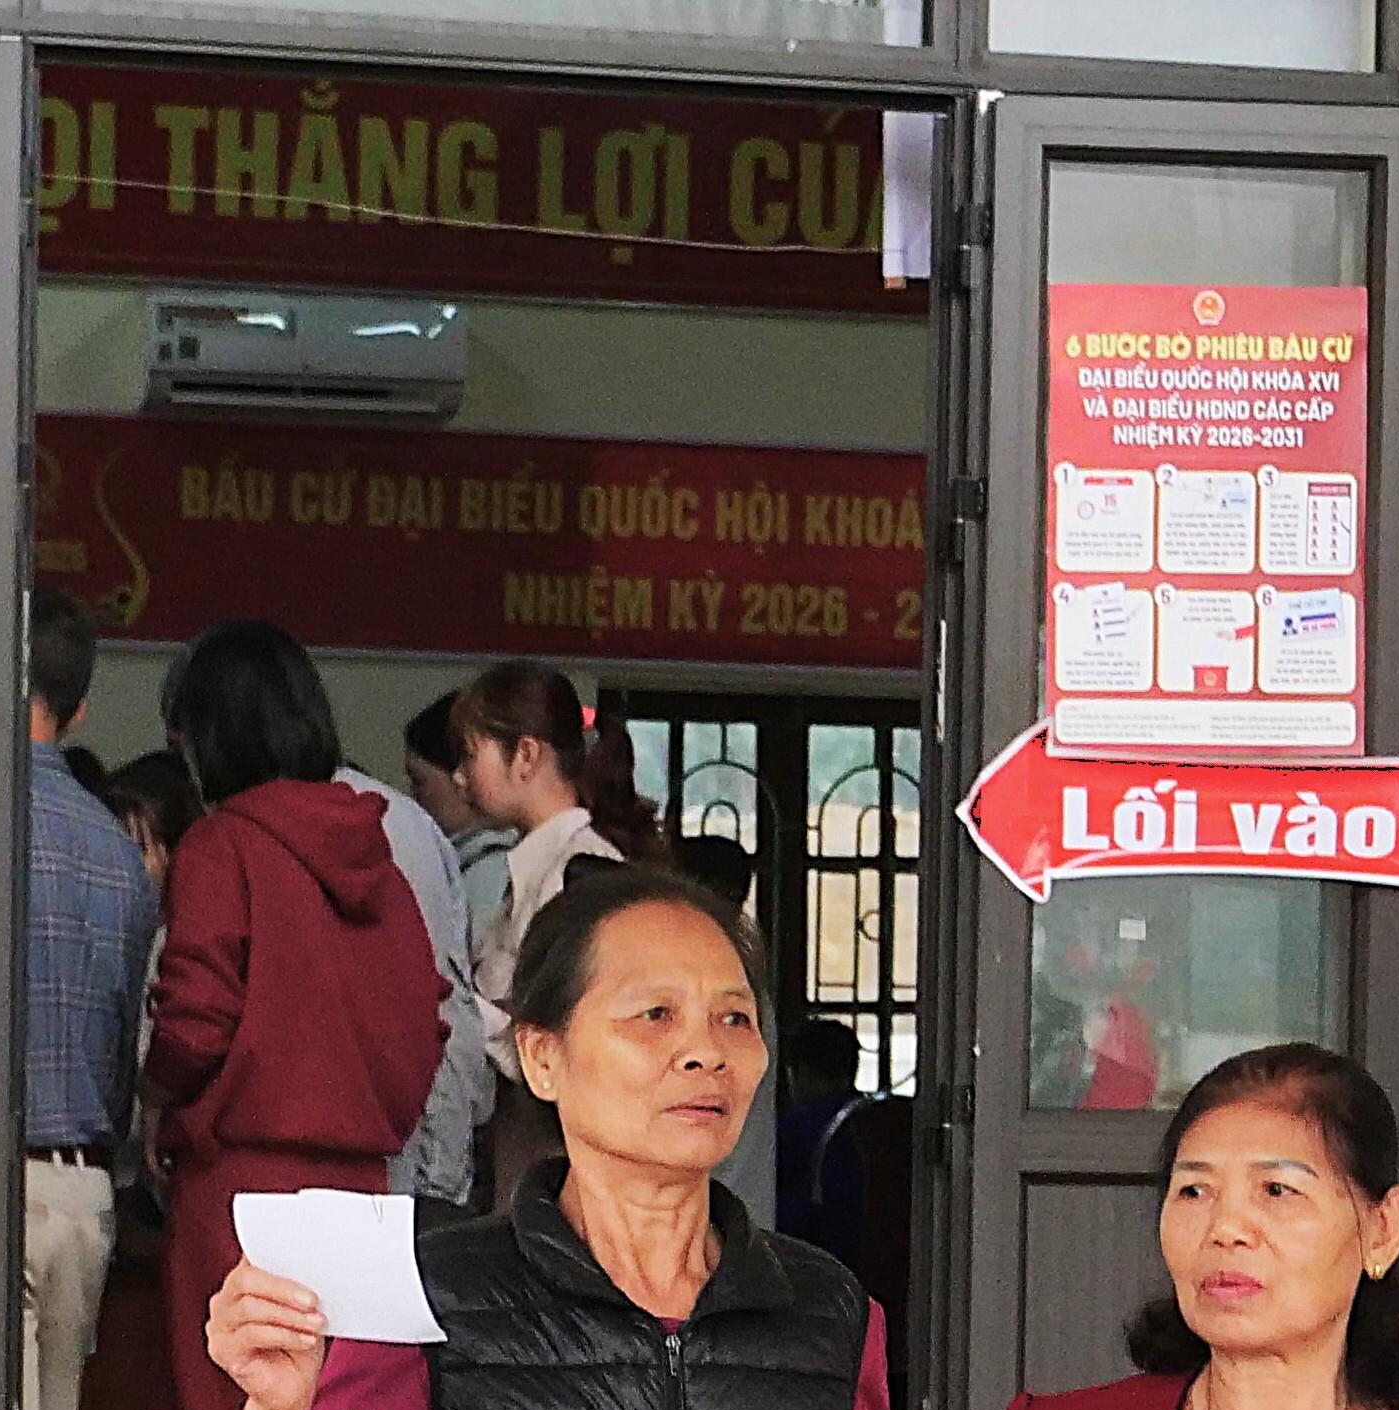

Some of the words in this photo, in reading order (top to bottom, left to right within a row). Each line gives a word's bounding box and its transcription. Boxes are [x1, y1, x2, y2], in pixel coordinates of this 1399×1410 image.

[154, 80, 499, 226] THẮNG
[538, 122, 690, 265] LỢI
[729, 105, 883, 250] CỦ
[1066, 336, 1081, 358] 6
[1079, 367, 1111, 393] ĐẠI
[1161, 365, 1212, 391] QUỐC
[1216, 366, 1248, 394] HỘI
[1308, 371, 1339, 392] XVI
[1083, 394, 1108, 418] VÀ
[1294, 398, 1335, 422] CẤP
[1114, 424, 1173, 449] NHIỆM
[1207, 426, 1303, 448] 2026-2031
[1162, 470, 1172, 486] 2
[1264, 471, 1273, 486] 3
[579, 467, 700, 542] QUỐC
[715, 480, 789, 555] HỘI
[504, 565, 653, 639] NHIỆM
[741, 583, 848, 637] 2026
[1059, 588, 1069, 604] 4
[1062, 779, 1198, 852] Lối
[1230, 791, 1396, 858] vào
